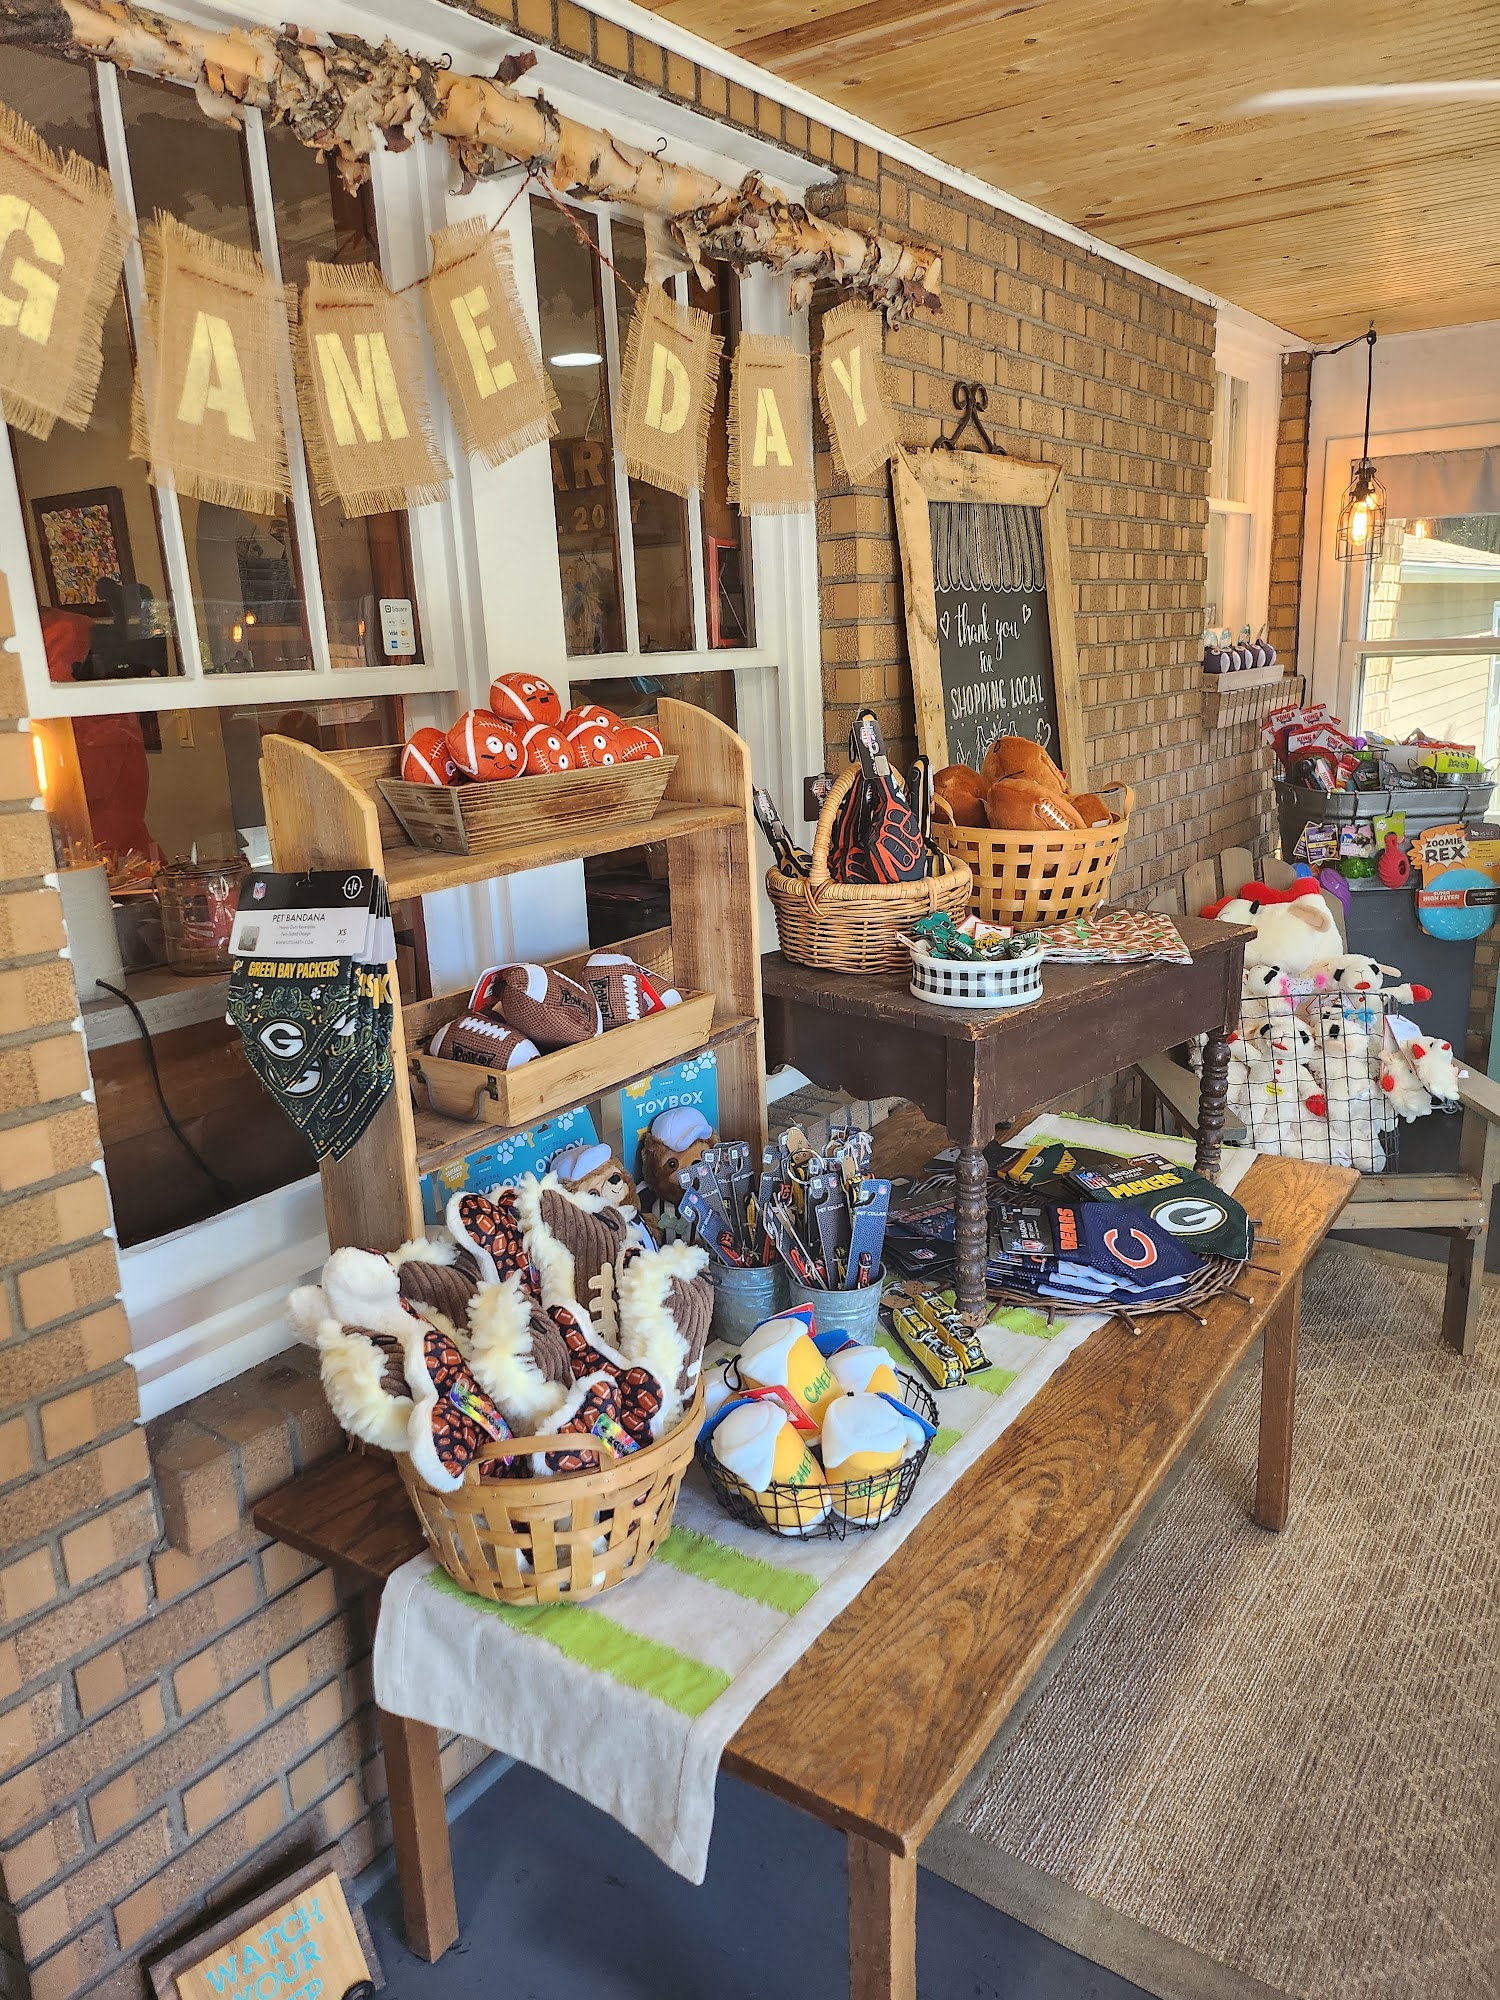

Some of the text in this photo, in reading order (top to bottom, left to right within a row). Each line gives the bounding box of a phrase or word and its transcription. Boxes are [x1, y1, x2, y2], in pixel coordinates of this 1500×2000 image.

[644, 343, 869, 468] DAY
[954, 602, 1021, 661] thank you
[950, 674, 1044, 720] SHOPPING LOCAL
[1425, 844, 1466, 863] REX
[1426, 837, 1463, 848] ZOOMIE
[272, 913, 326, 923] PET BANDANA
[338, 928, 347, 936] XS
[247, 959, 341, 979] GREEN BAY PACKERS
[635, 1090, 703, 1117] TOYBOX
[1107, 1166, 1145, 1178] BANDANA
[1112, 1175, 1124, 1183] PET
[1105, 1172, 1184, 1199] PACKERS
[827, 1203, 845, 1211] COLLAR
[1057, 1207, 1078, 1251] BEARS
[803, 1362, 832, 1404] CHEE
[205, 1897, 325, 1993] WATCH
